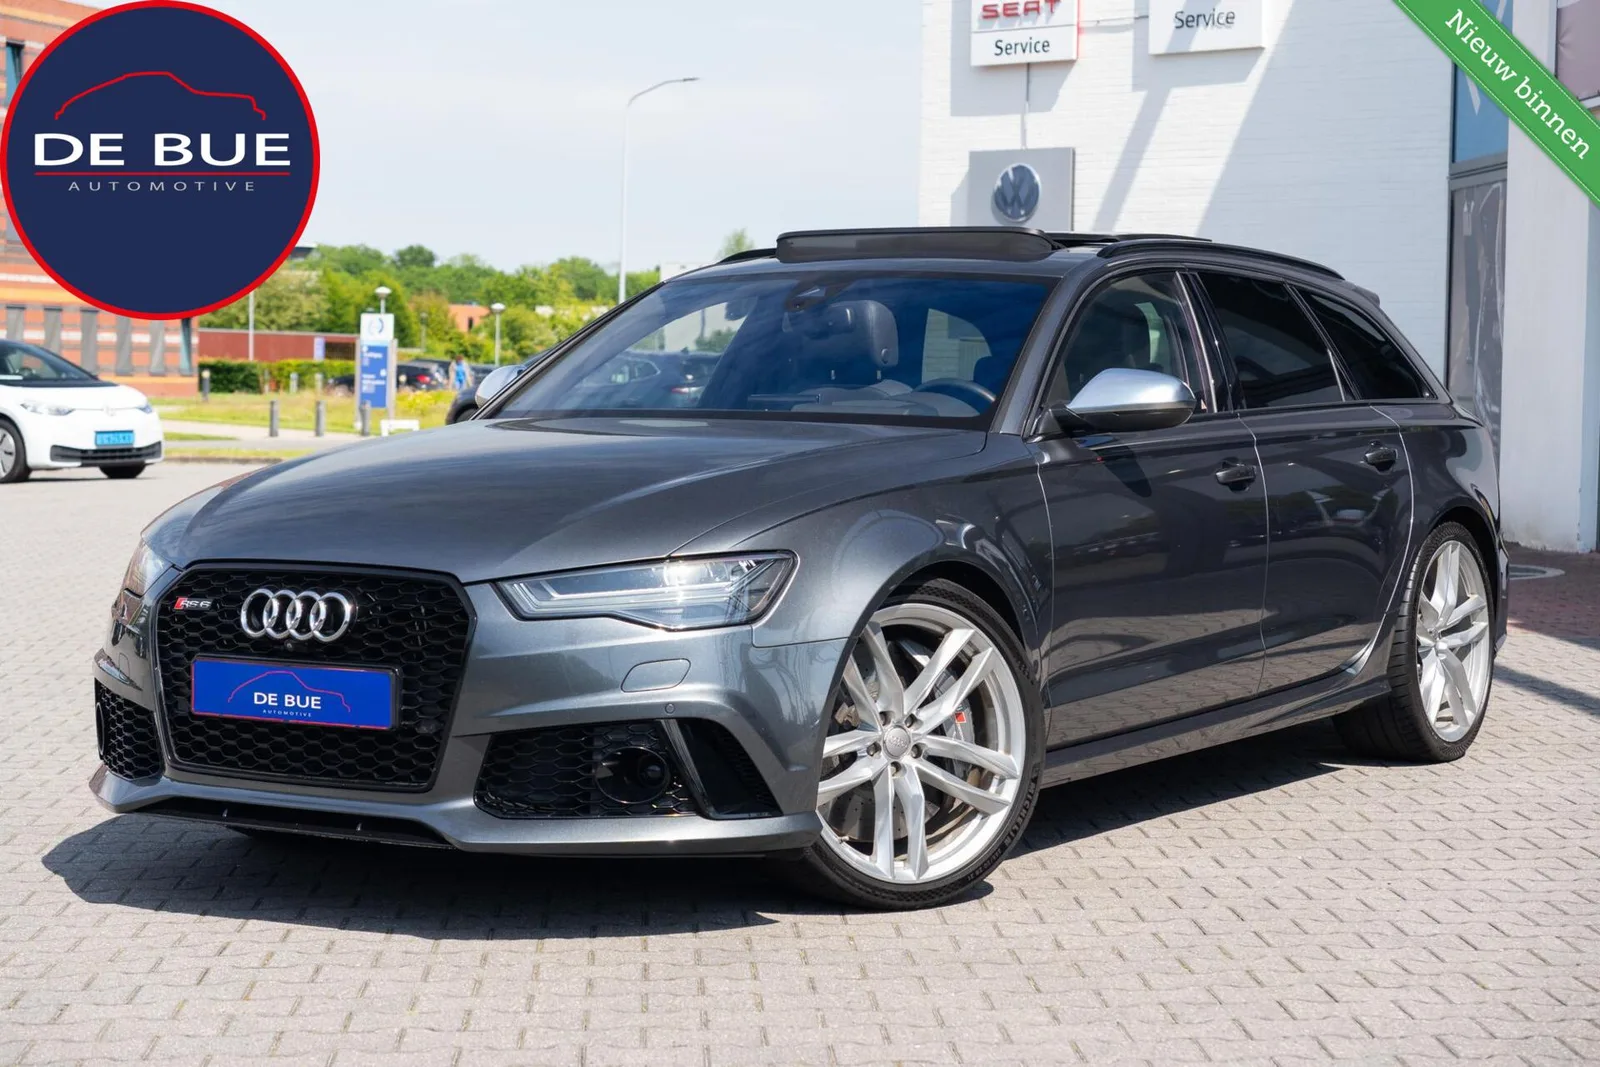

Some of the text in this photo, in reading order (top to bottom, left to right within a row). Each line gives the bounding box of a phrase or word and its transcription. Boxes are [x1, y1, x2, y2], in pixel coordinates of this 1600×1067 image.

[982, 0, 1061, 19] SEAT
[1174, 8, 1235, 29] Service
[994, 37, 1050, 56] Service
[253, 692, 322, 709] DE BUE
[262, 709, 312, 717] AUTOMOTIVE
